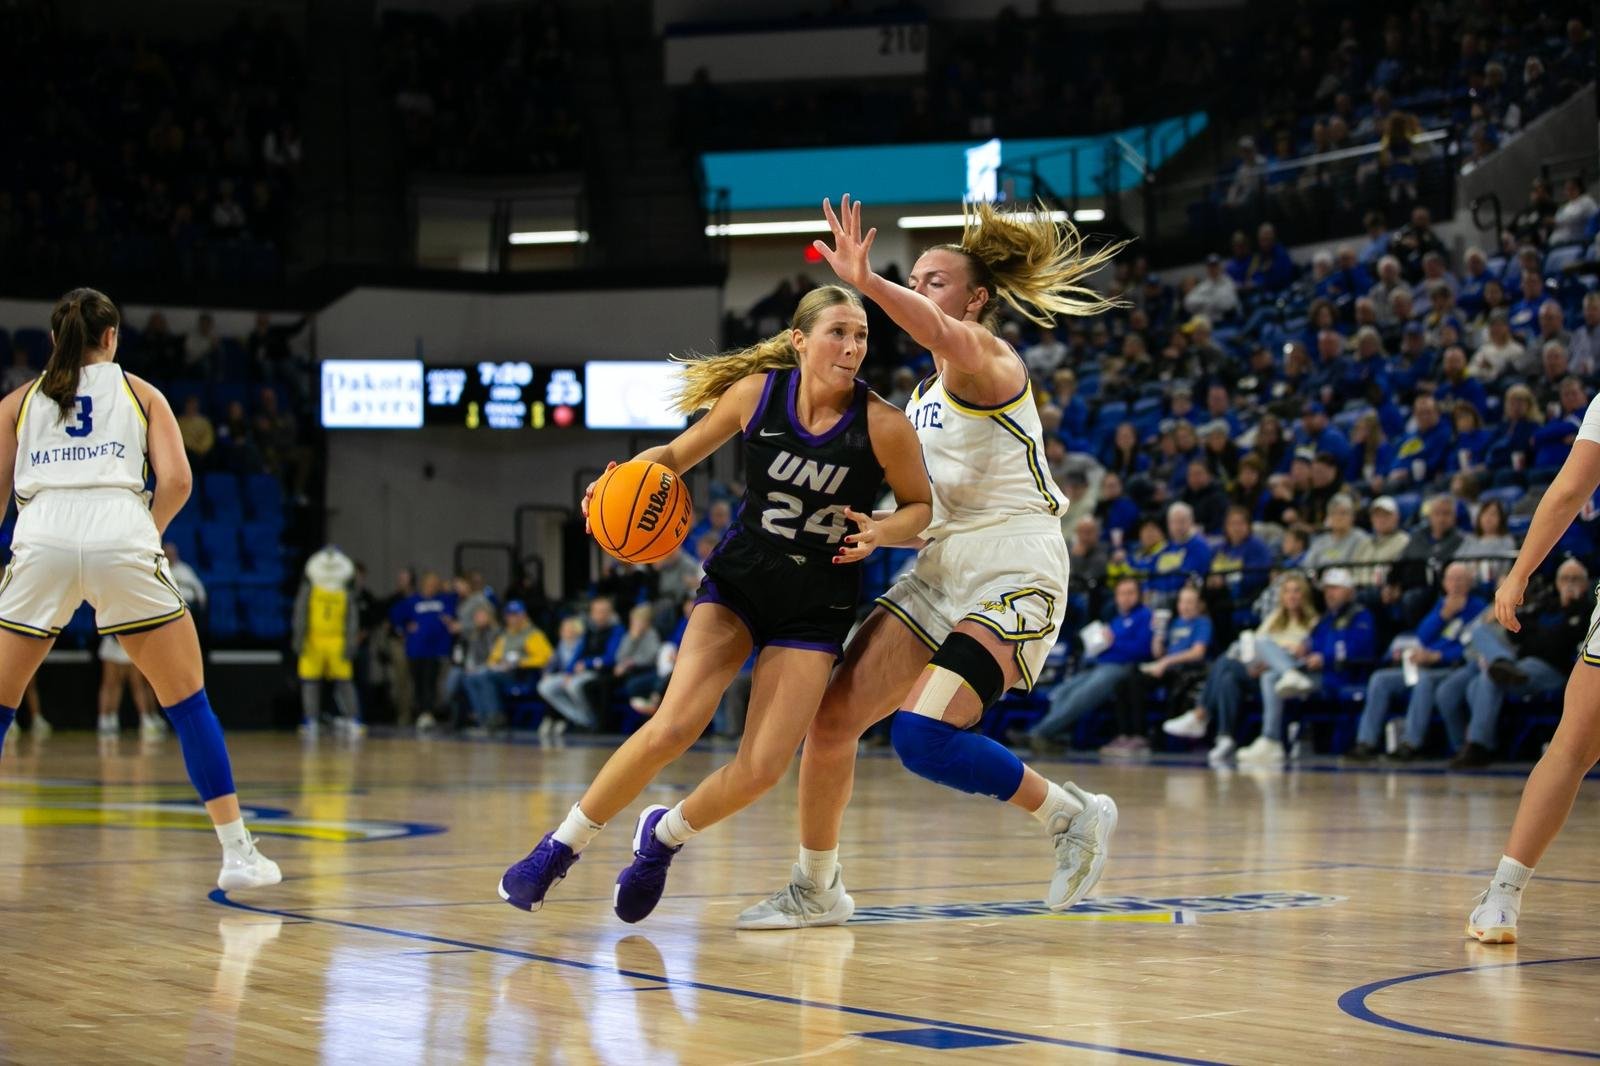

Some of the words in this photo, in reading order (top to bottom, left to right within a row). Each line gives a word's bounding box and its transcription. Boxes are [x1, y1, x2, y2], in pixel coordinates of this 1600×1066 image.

[65, 396, 93, 437] 3
[31, 441, 125, 467] MATHIOWETZ
[766, 450, 849, 495] UNI
[637, 472, 672, 532] Wilson
[761, 491, 851, 545] 24
